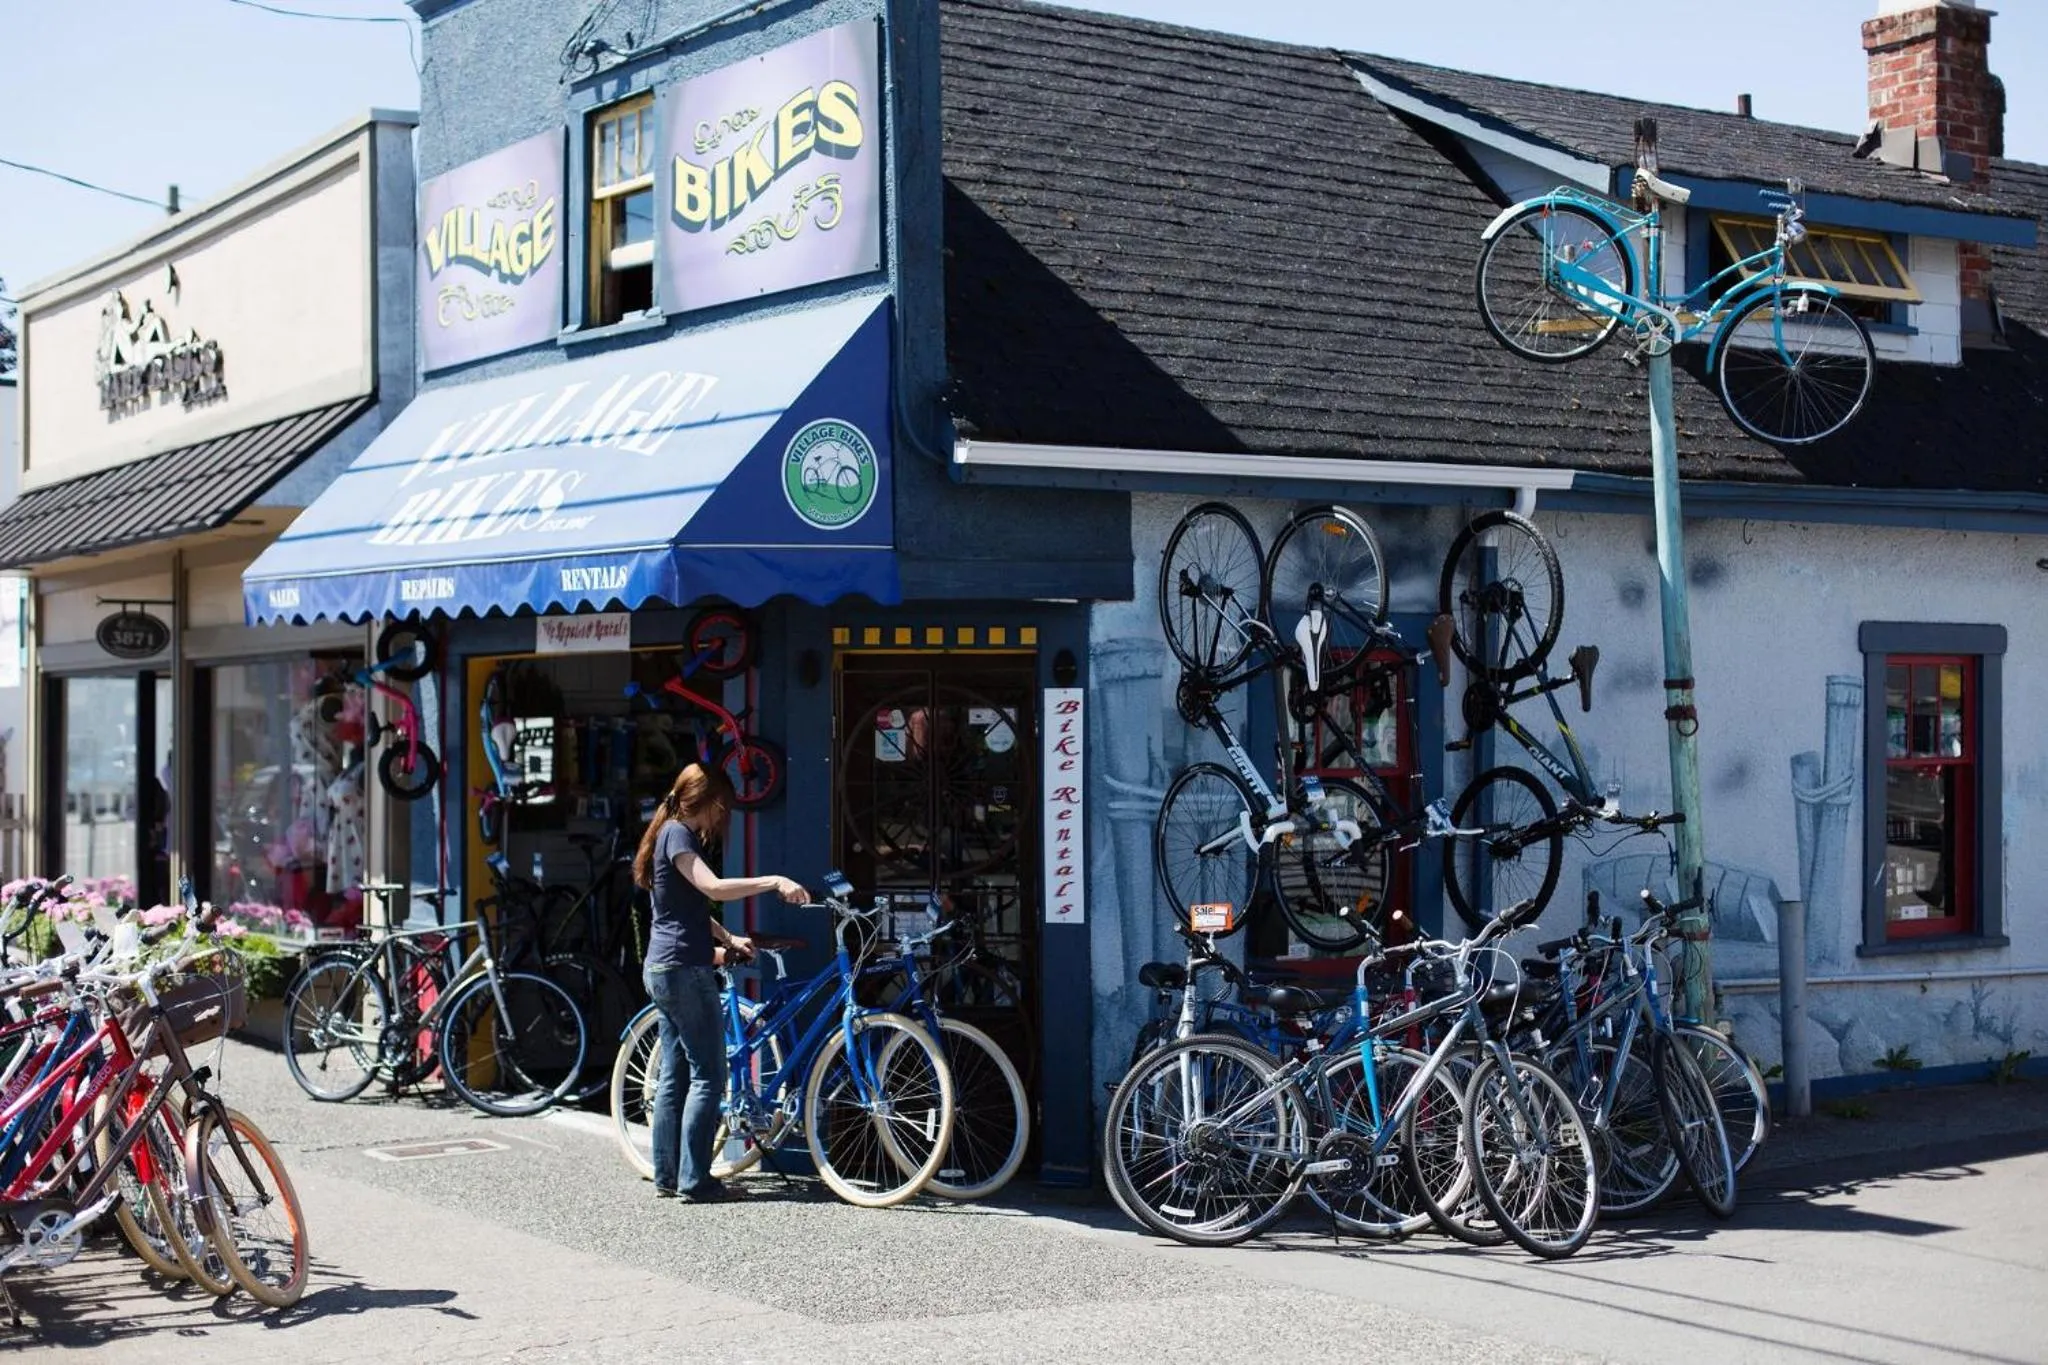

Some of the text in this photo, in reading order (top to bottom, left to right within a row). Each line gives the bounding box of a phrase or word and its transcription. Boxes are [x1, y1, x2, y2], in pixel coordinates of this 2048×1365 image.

[671, 80, 864, 232] BIKES
[423, 197, 558, 284] VILLAGE
[399, 371, 720, 487] VILLAGE
[791, 427, 869, 464] VILLAGE BIKES
[366, 468, 587, 545] BIKES
[269, 588, 300, 608] SALES
[401, 577, 455, 600] REPAIRS
[561, 566, 628, 591] RENTALS
[1227, 744, 1266, 796] GIANT
[1528, 746, 1571, 779] GIANT
[1050, 786, 1081, 914] Rentals
